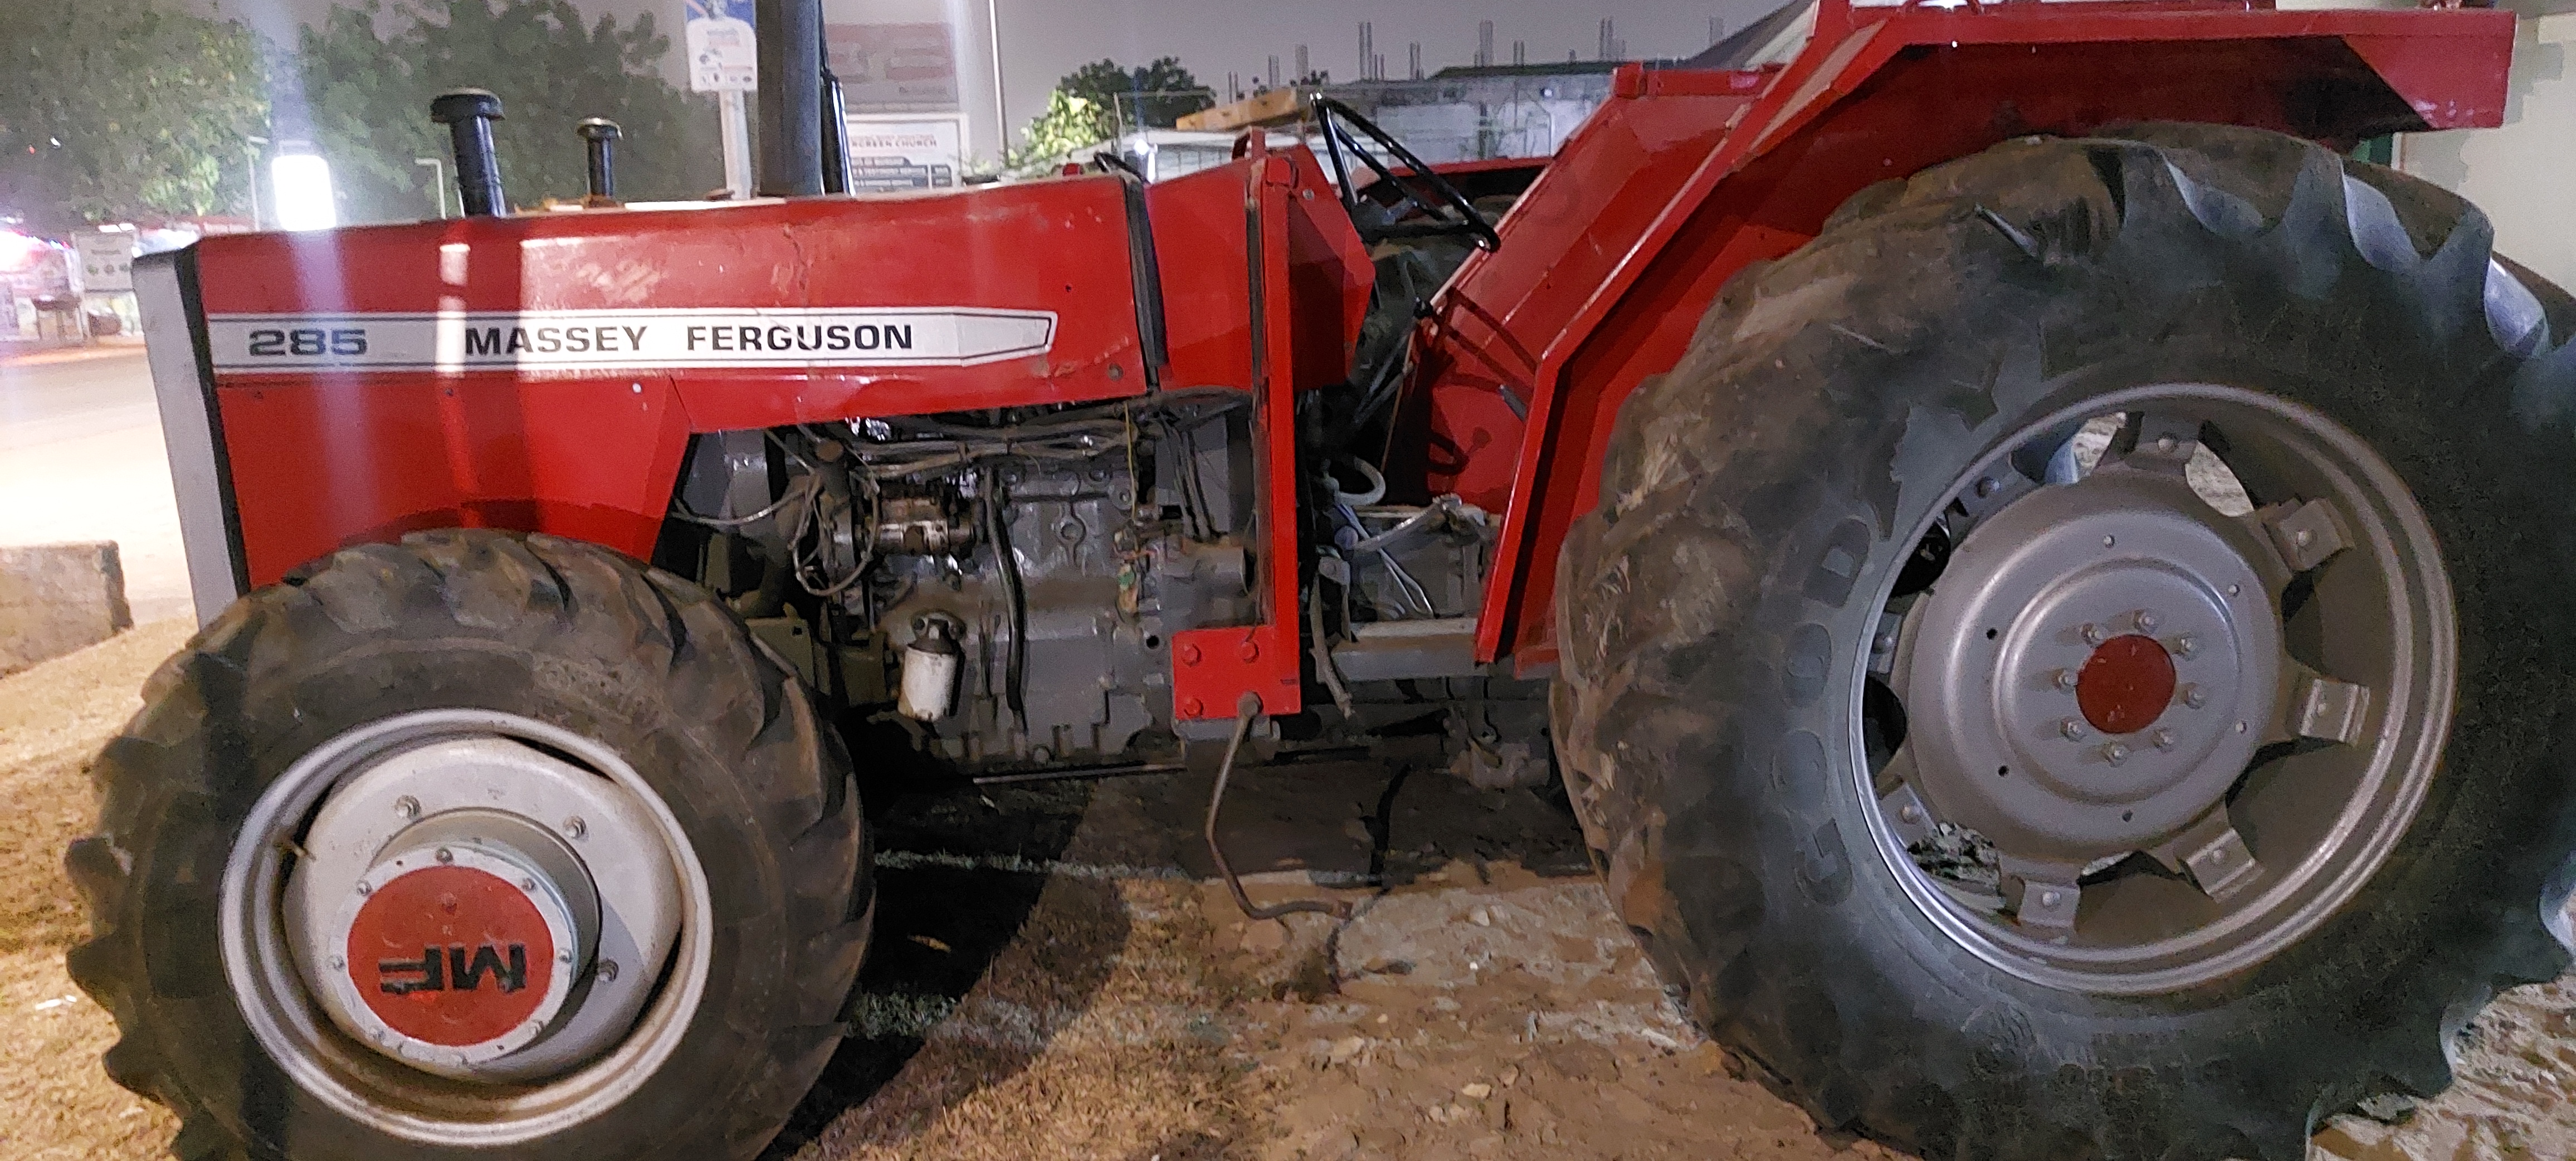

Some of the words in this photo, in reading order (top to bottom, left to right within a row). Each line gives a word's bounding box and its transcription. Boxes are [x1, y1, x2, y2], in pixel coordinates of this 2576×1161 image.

[895, 139, 937, 147] CHURCH
[248, 328, 367, 356] 285
[465, 325, 647, 356] MASSEY
[687, 324, 912, 351] FERGUSON
[378, 943, 526, 994] MF
